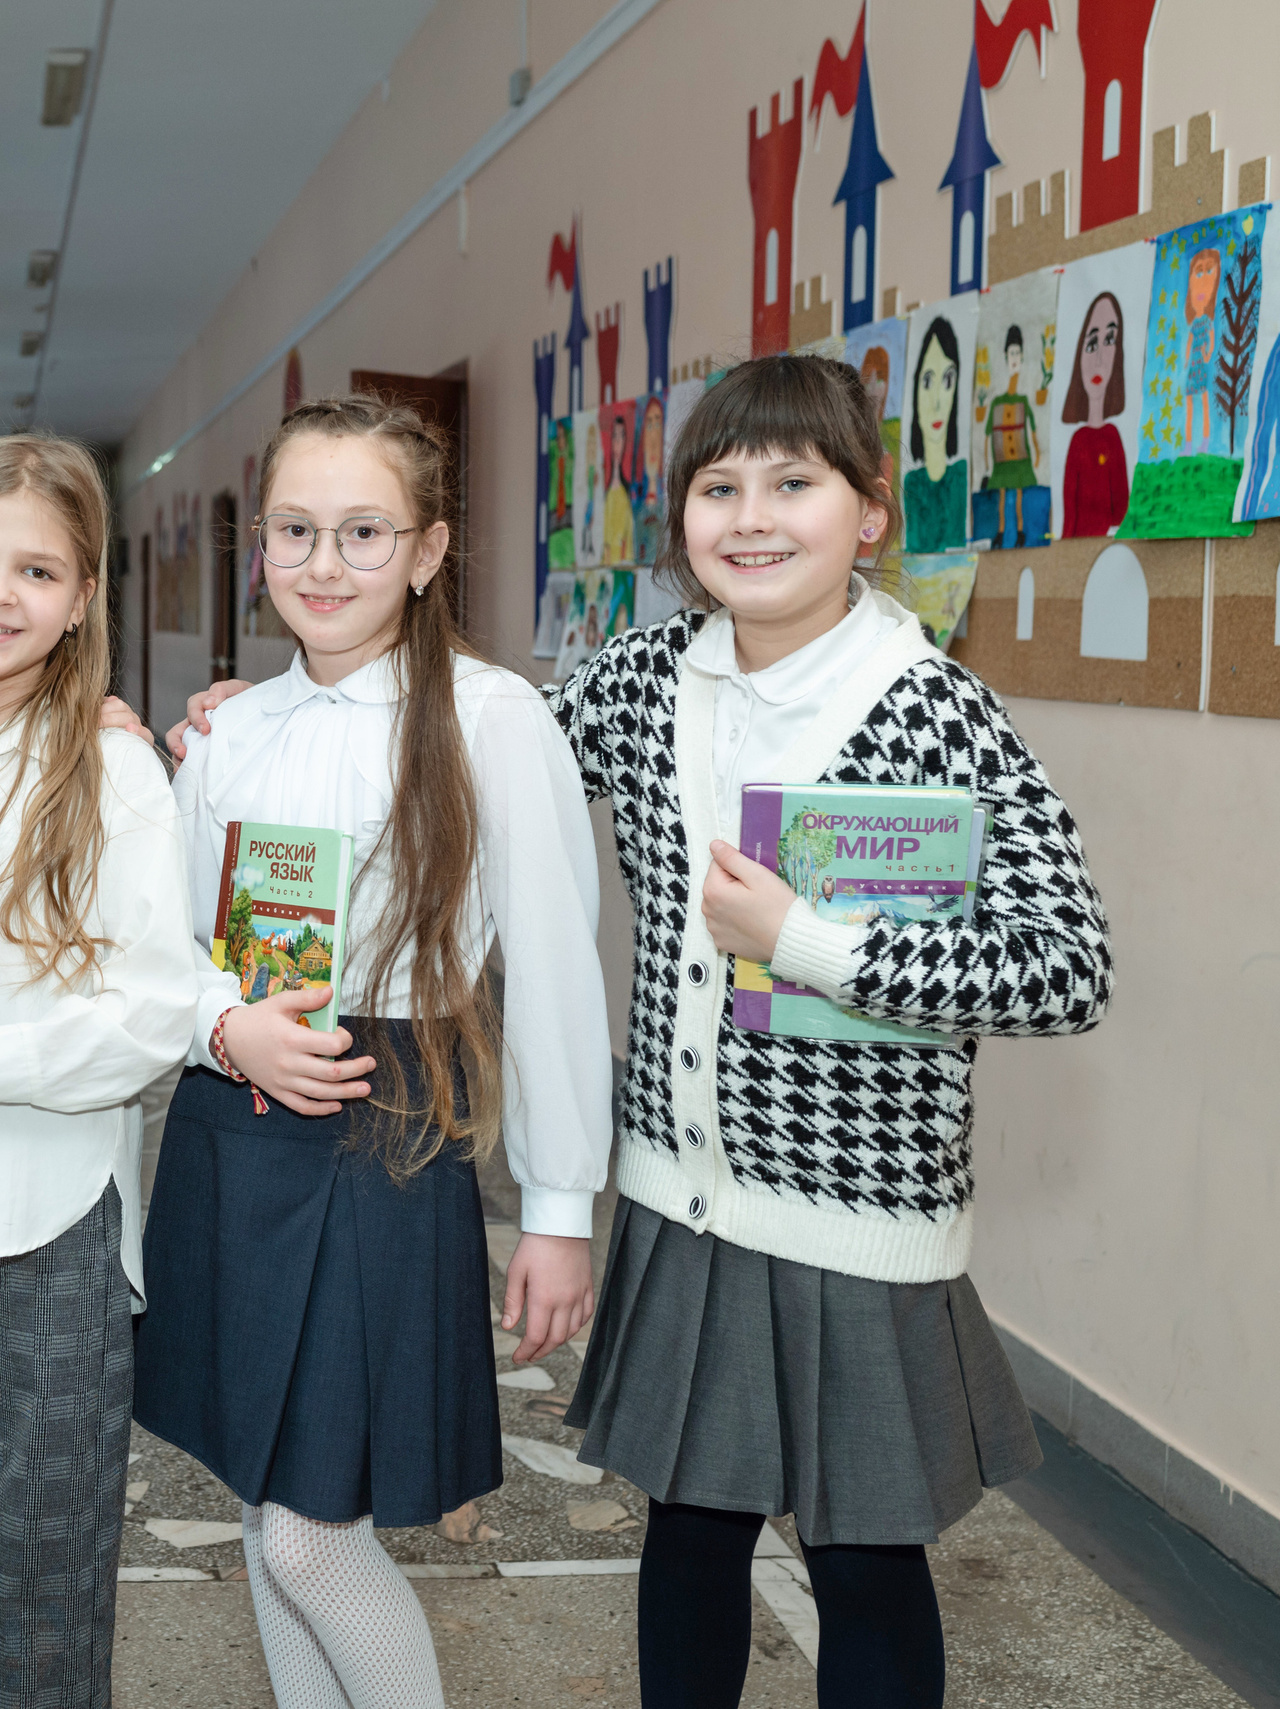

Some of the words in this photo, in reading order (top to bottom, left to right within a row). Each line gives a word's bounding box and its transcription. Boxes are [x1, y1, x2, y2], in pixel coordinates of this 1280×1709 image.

[802, 813, 960, 835] ОКРУЖАЮЩИЙ
[248, 840, 317, 864] РУССКИЙ
[835, 835, 921, 861] МИР
[269, 862, 314, 883] ЯЗЫК
[949, 864, 955, 873] 1
[308, 890, 314, 899] 2
